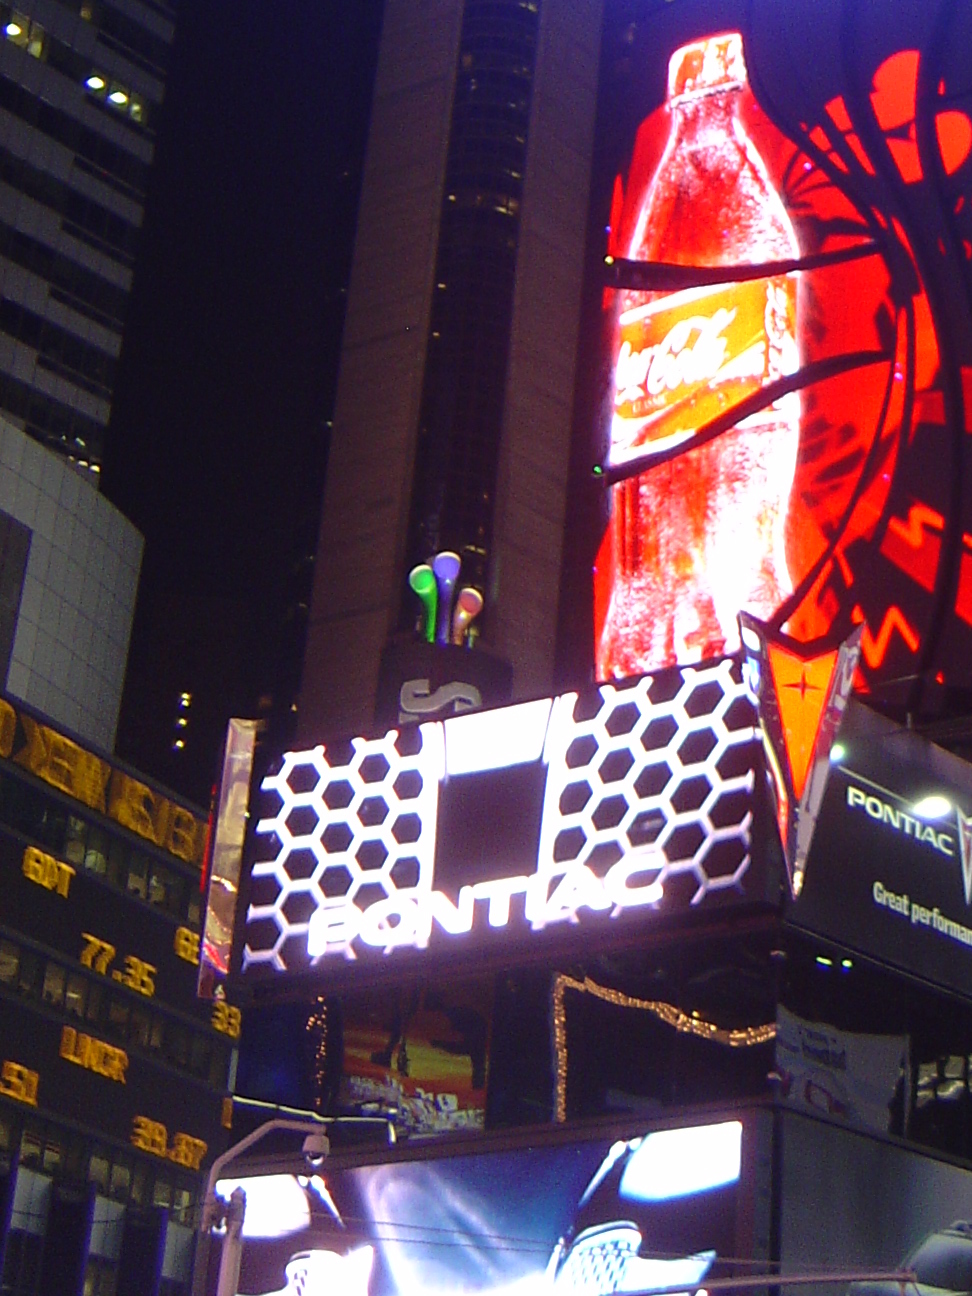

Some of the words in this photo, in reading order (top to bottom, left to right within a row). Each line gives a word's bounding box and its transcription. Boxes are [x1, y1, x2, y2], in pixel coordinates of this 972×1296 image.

[847, 785, 955, 856] PONTIAC
[306, 847, 664, 958] PONTIAC
[873, 881, 909, 917] Great
